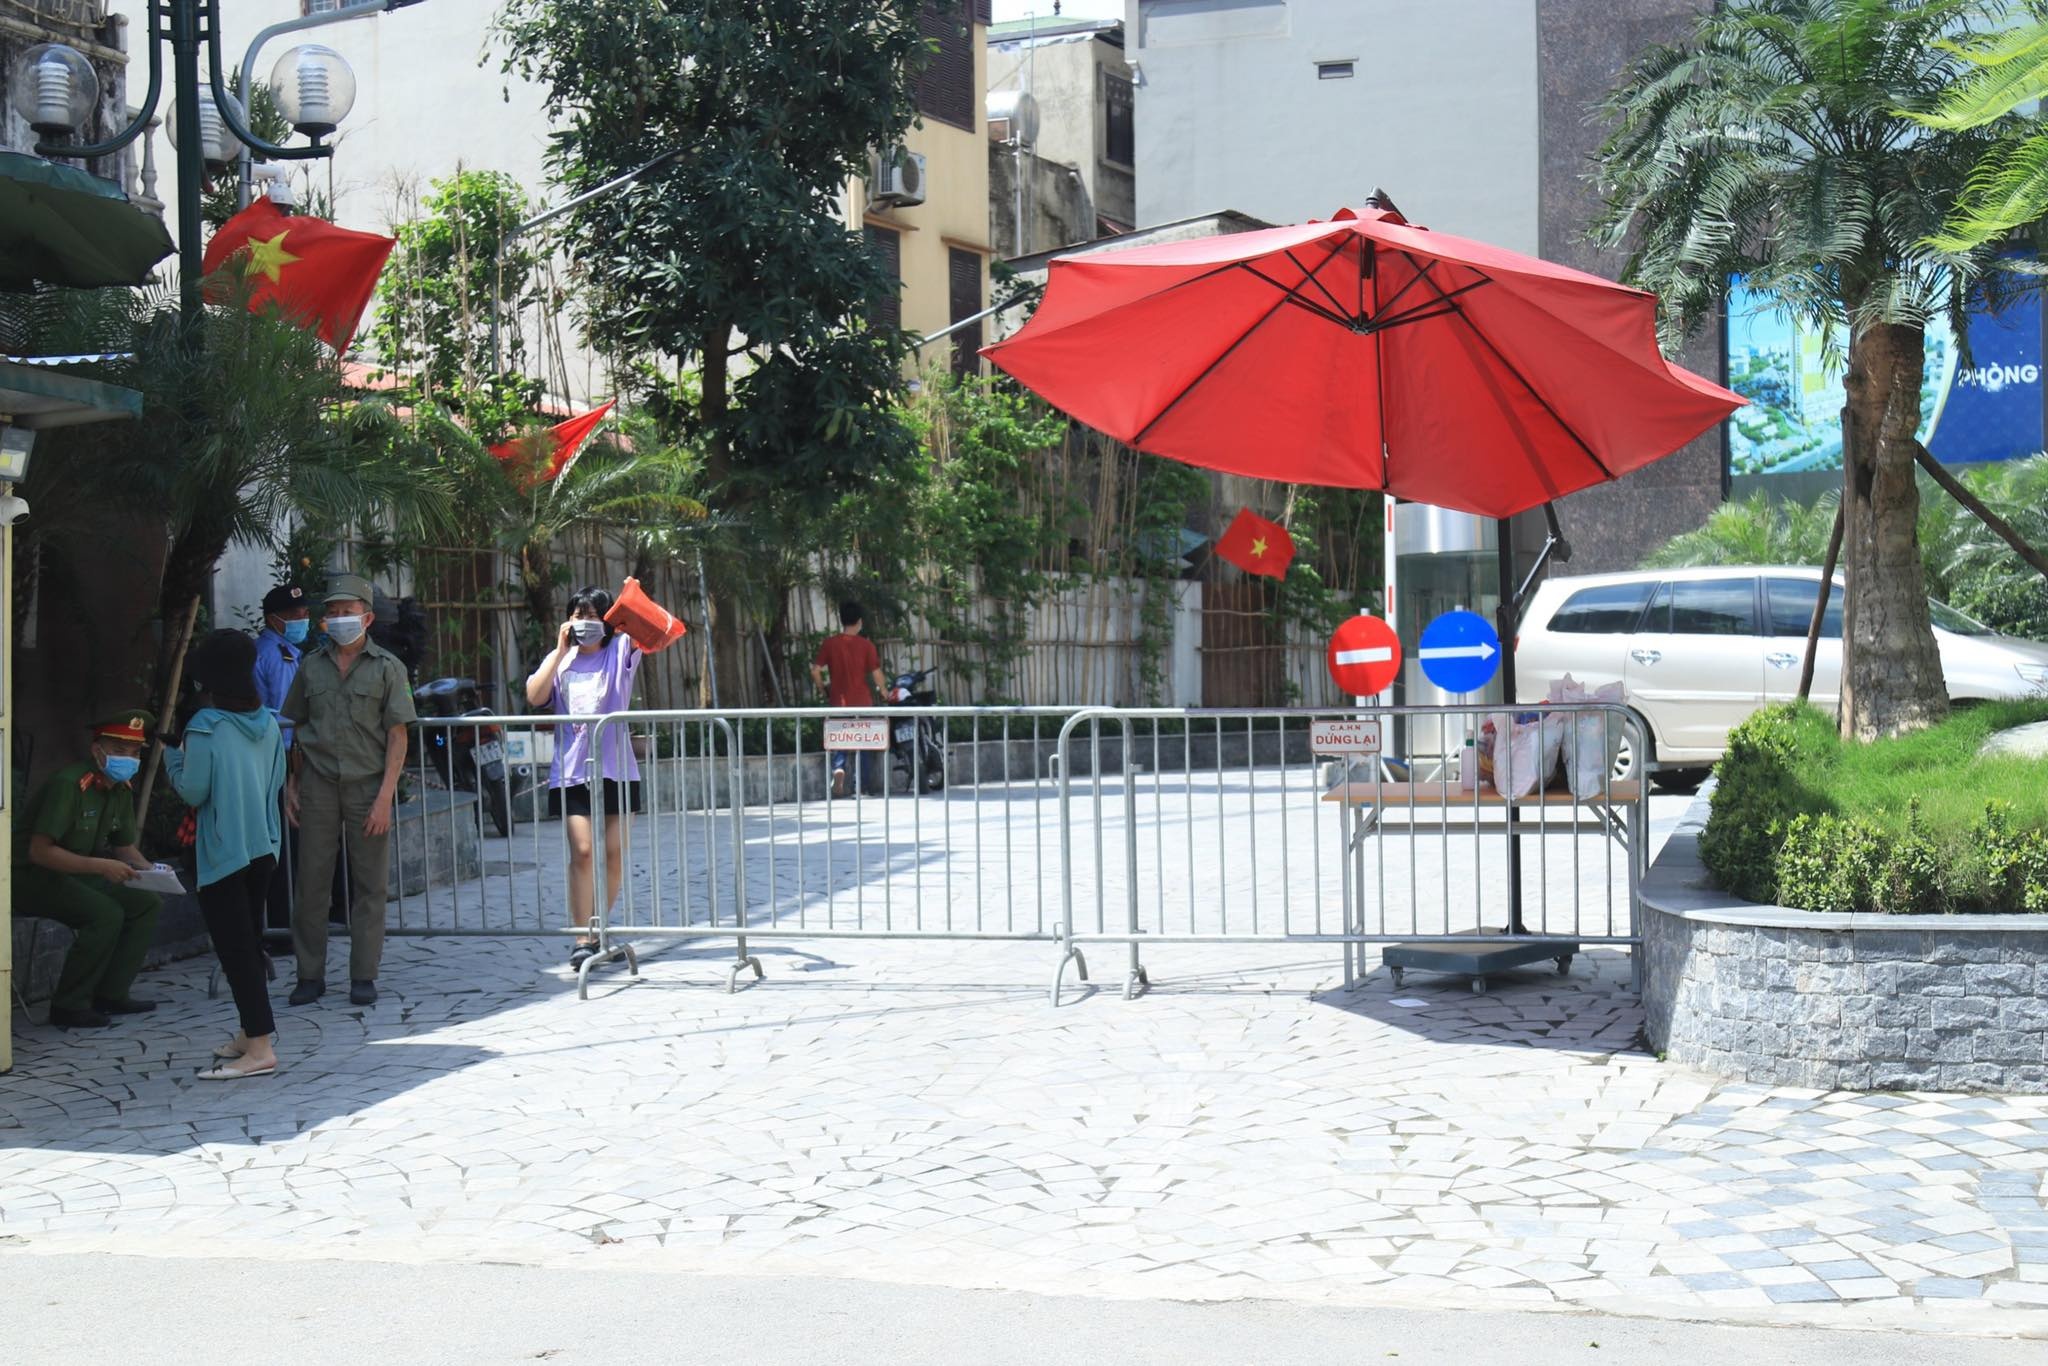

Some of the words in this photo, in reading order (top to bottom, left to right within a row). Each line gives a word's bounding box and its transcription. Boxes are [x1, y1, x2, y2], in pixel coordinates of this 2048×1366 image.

[1958, 361, 2039, 388] PHÒNG
[1315, 732, 1352, 744] DỪNG
[1354, 735, 1376, 747] LẠI
